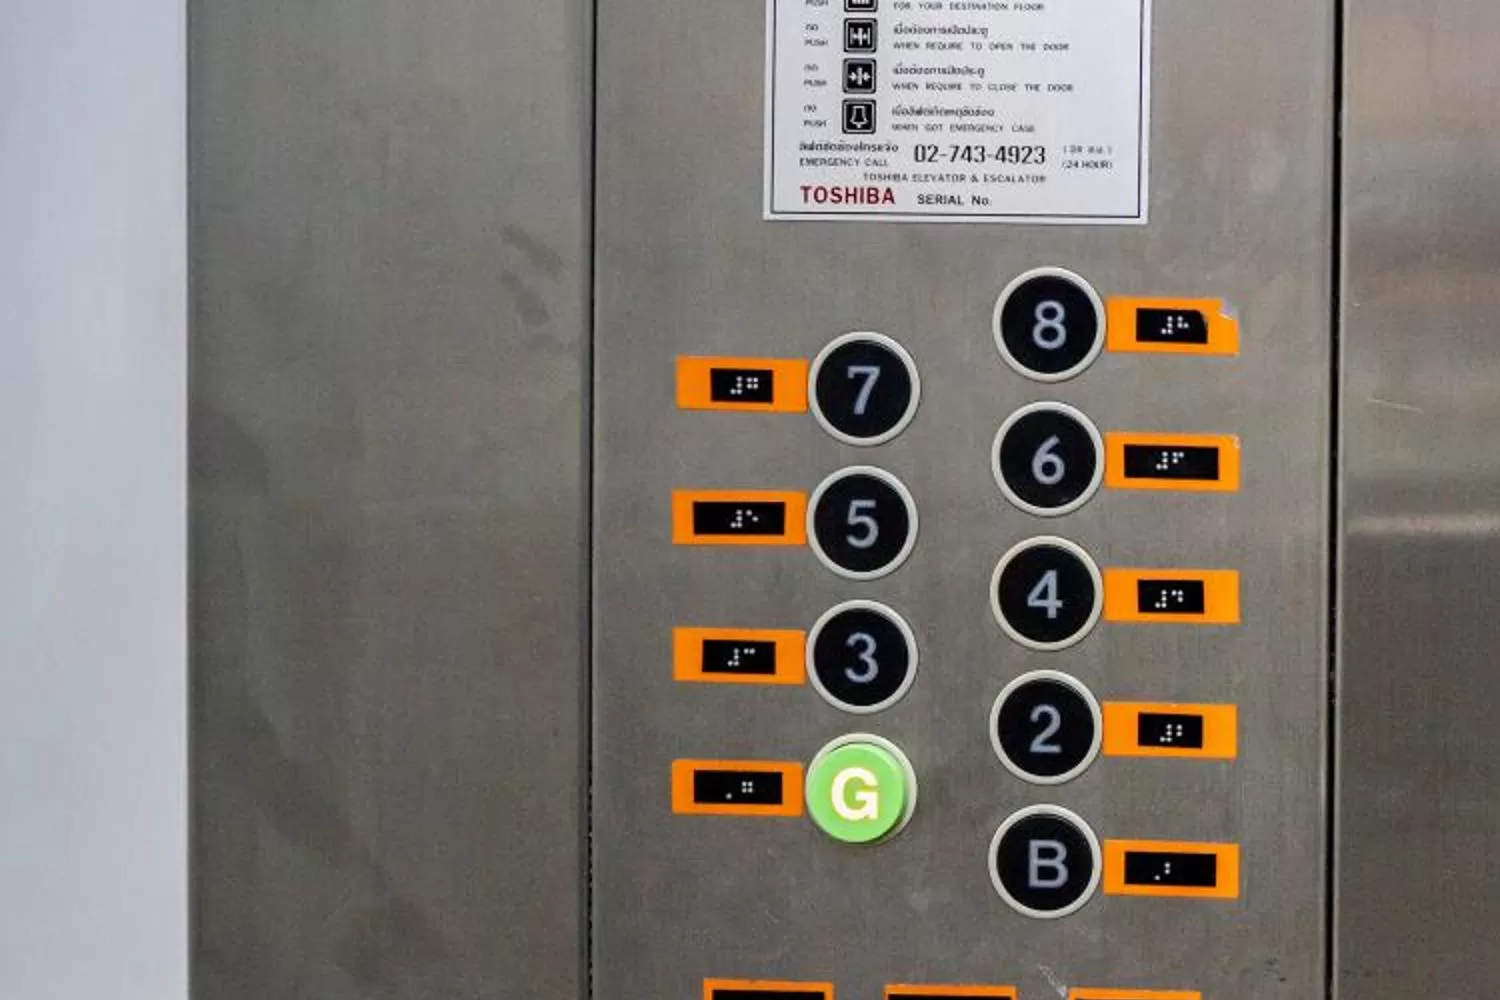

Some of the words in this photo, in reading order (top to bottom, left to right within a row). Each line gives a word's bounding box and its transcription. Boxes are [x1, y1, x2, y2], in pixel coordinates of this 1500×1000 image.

[893, 2, 911, 10] FOR
[919, 2, 942, 10] YOUR
[950, 2, 1008, 11] DESTINATION
[1014, 3, 1044, 11] FLOOR
[970, 42, 982, 50] TO
[988, 43, 1013, 51] OPEN
[1020, 43, 1036, 51] THE
[1043, 43, 1070, 51] DOOR
[892, 82, 918, 91] WHEN
[970, 83, 982, 91] TO
[988, 83, 1016, 92] CLOSE
[1025, 83, 1040, 92] THE
[1047, 83, 1074, 92] DOOR
[803, 120, 827, 128] PUSH
[925, 124, 943, 132] GOT
[950, 124, 1003, 132] EMERGENCY
[799, 157, 859, 167] EMERGENCY
[864, 157, 888, 167] CALL
[913, 143, 1046, 165] 02-743-4923
[864, 172, 909, 182] TOSHIBA
[912, 173, 966, 183] ELEVATOR
[970, 174, 979, 183] &
[983, 174, 1046, 184] ESCALATOR
[800, 185, 896, 205] TOSHIBA
[917, 193, 964, 206] SERIAL
[1033, 299, 1066, 350] 8
[846, 364, 881, 416] 7
[1031, 435, 1065, 486] 6
[845, 499, 879, 549] 5
[1027, 569, 1063, 619] 4
[845, 632, 879, 684] 3
[1029, 704, 1062, 753] 2
[831, 767, 880, 821] G
[1028, 839, 1069, 890] B
